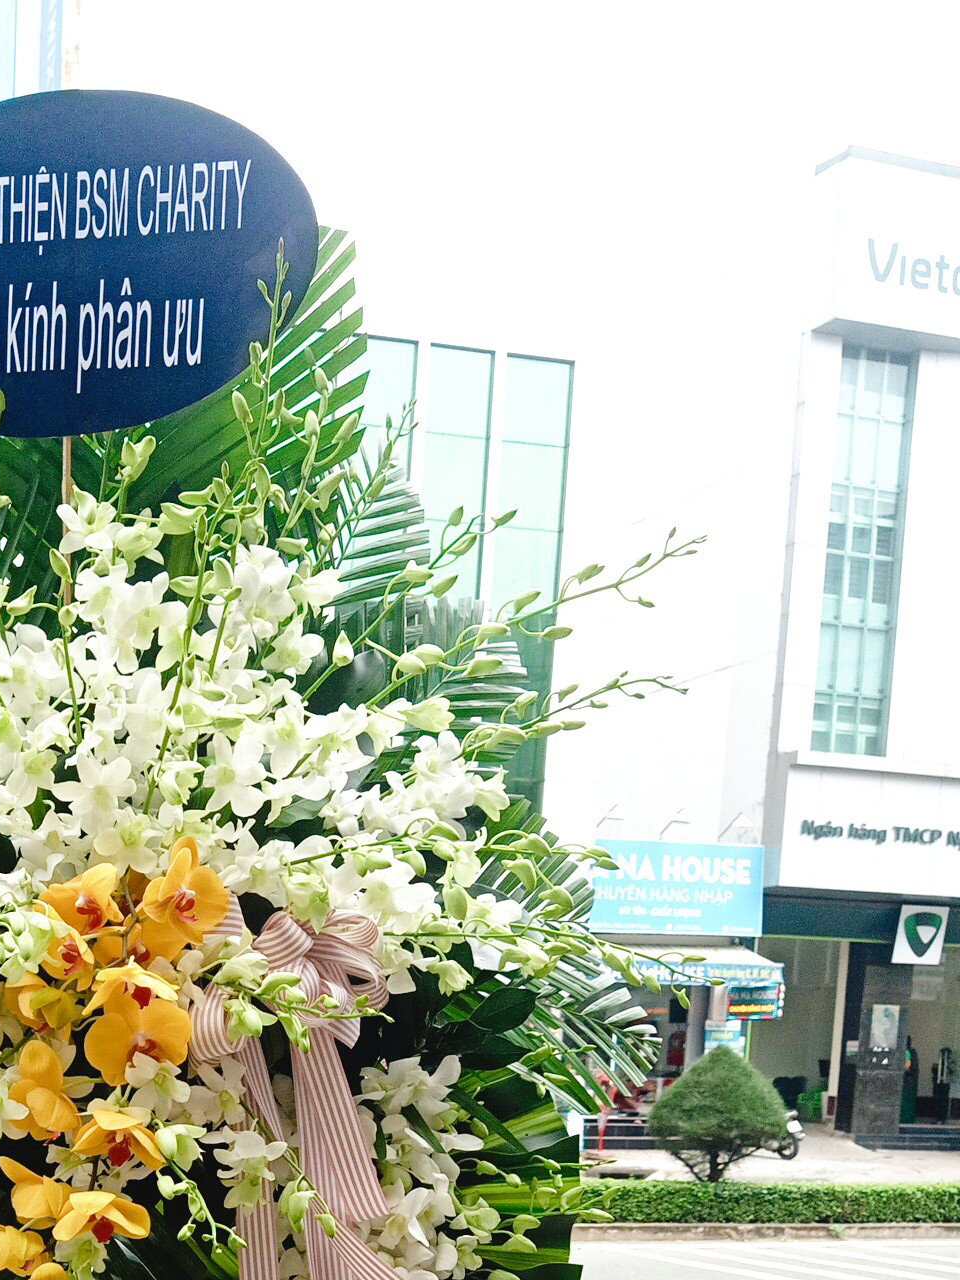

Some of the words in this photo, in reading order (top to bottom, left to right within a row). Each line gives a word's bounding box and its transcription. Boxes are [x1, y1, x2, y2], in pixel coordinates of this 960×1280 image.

[75, 168, 129, 240] BSM
[136, 159, 252, 236] CHARITY
[6, 281, 66, 375] kính
[76, 277, 153, 395] phân
[162, 297, 205, 368] ưu
[892, 826, 942, 845] TMCP
[662, 855, 751, 885] HOUSE
[650, 885, 690, 903] HÀNG
